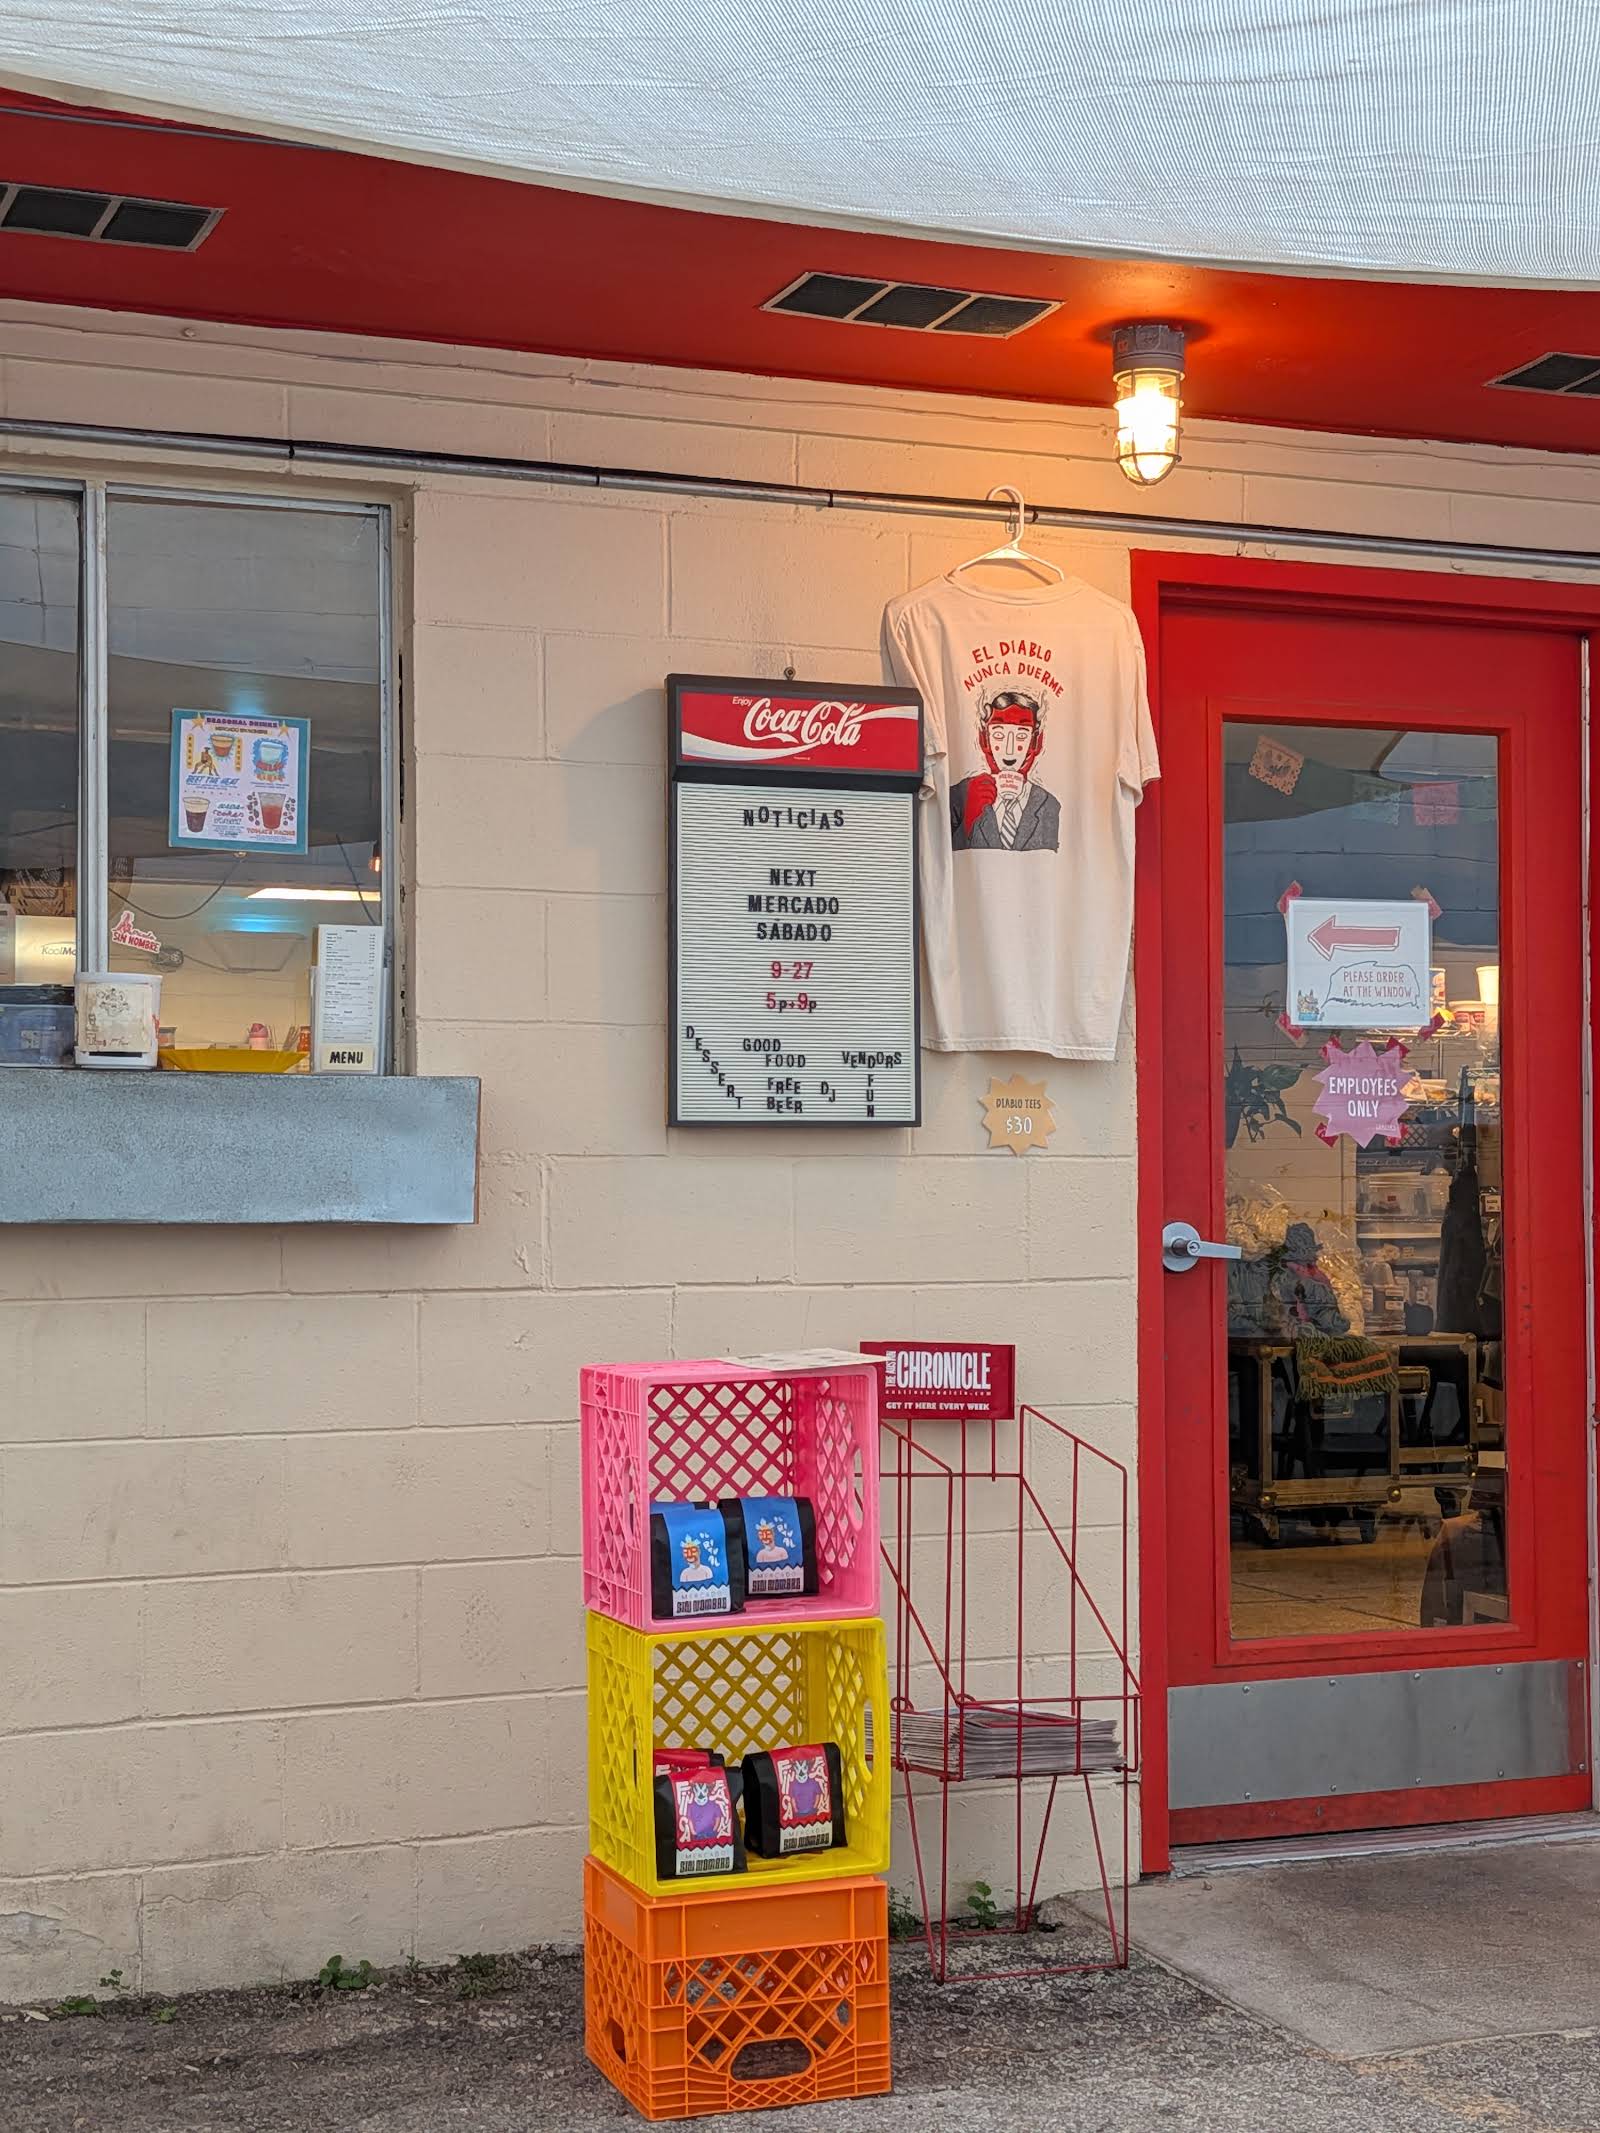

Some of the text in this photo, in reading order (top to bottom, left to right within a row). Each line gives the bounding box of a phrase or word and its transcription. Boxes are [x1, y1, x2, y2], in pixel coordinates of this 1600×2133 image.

[972, 639, 1052, 664] EL DIABLO
[964, 661, 1064, 698] NUNCA DUERME
[731, 696, 753, 707] Enjoy
[249, 720, 278, 728] DRINKS
[743, 697, 866, 746] Coca-Cola
[743, 806, 845, 830] NOTICIAS
[769, 868, 817, 888] NEXT
[747, 894, 840, 914] MERCADO
[113, 931, 158, 952] SIN NOMBRE
[771, 960, 814, 980] 9-27
[1343, 970, 1404, 983] PLEASE ORDER
[1343, 985, 1412, 998] AT THE WINDOW
[742, 1037, 782, 1052] GOOD
[329, 1051, 364, 1064] MENU
[765, 1053, 806, 1069] FOOD
[841, 1050, 902, 1069] VENDORS
[685, 1025, 744, 1110] DESSERT
[767, 1077, 801, 1095] FREE
[820, 1080, 837, 1103] DJ
[865, 1073, 876, 1118] FUN
[1328, 1076, 1398, 1097] EMPLOYEES
[766, 1096, 804, 1114] BEER
[995, 1098, 1042, 1110] DIABLO TEES
[1347, 1099, 1379, 1118] ONLY
[1006, 1115, 1032, 1135] $30
[897, 1351, 991, 1390] CHRONICLE
[915, 1402, 937, 1411] HERE
[939, 1402, 965, 1411] EVERY
[966, 1402, 990, 1411] WEEK
[752, 1579, 766, 1592] SIN
[676, 1600, 692, 1613] SIN
[783, 1837, 798, 1850] SIN
[680, 1860, 695, 1873] SIN
